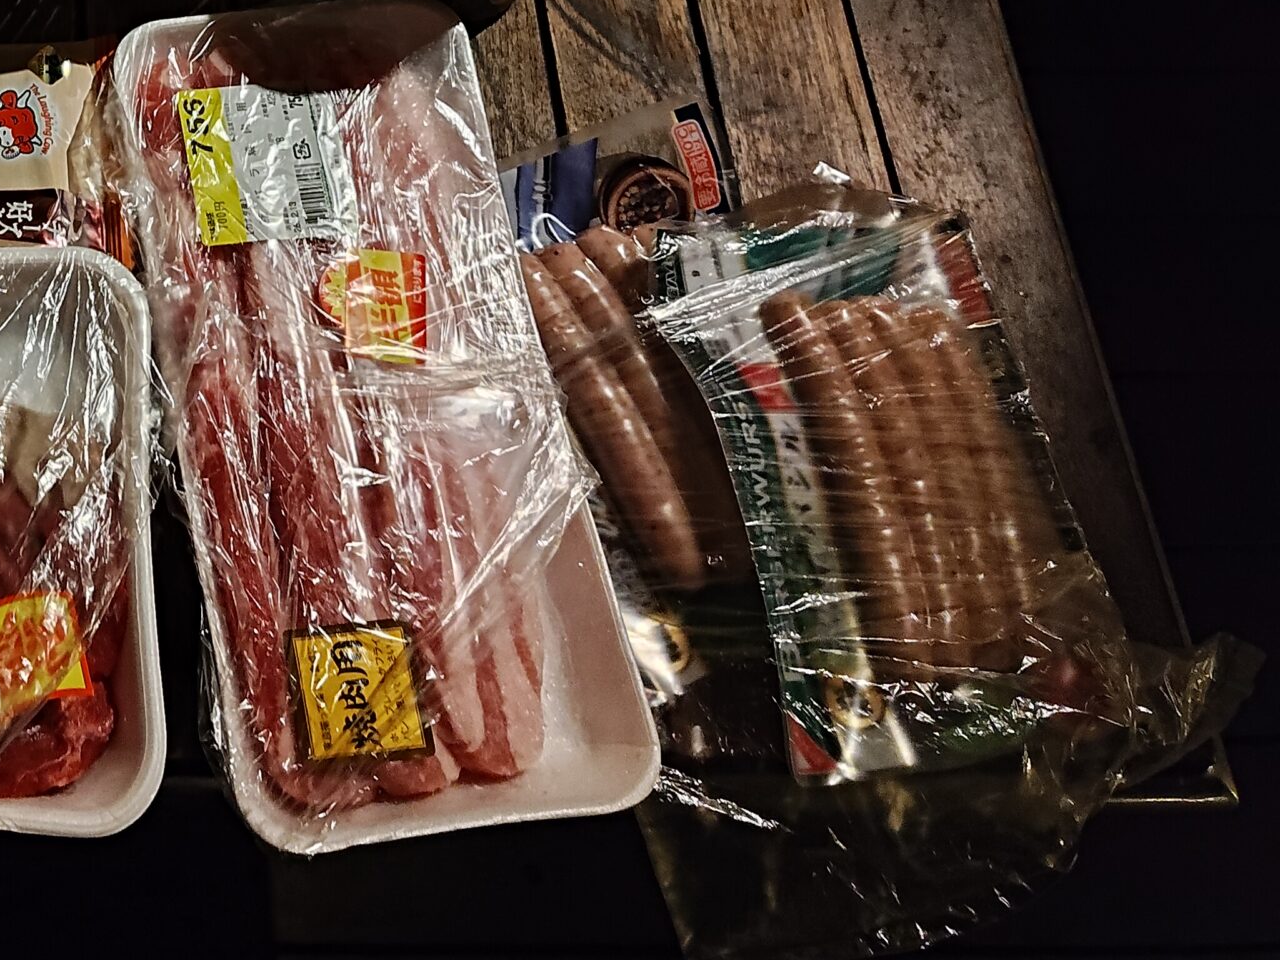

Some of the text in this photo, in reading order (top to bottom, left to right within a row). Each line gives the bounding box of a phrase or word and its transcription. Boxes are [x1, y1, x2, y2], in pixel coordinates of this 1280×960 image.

[29, 83, 44, 97] The
[37, 96, 54, 137] Laughing
[182, 97, 214, 156] 756
[687, 152, 718, 207] 要冷蔵
[330, 640, 383, 748] 焼肉用
